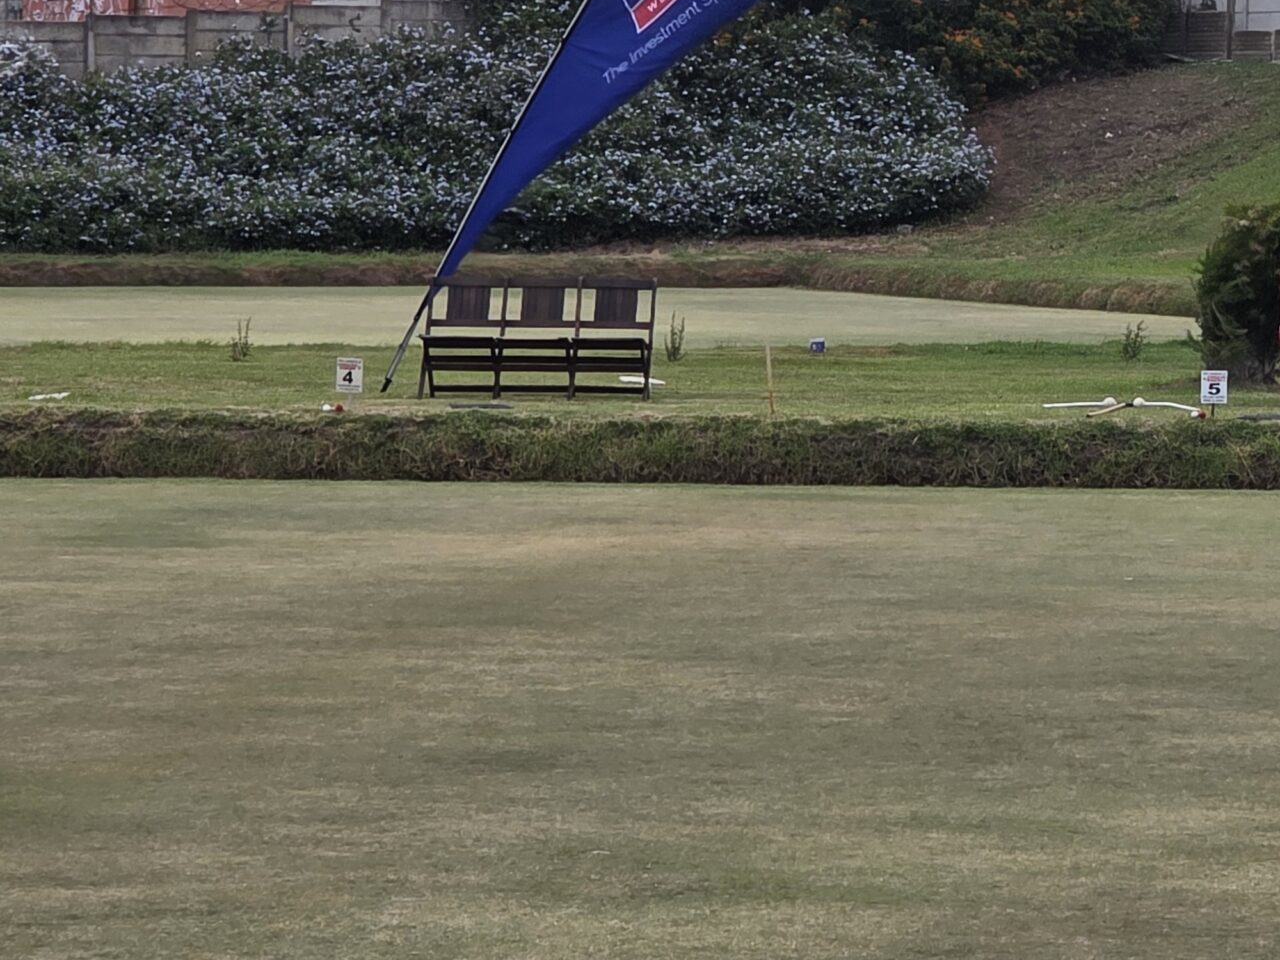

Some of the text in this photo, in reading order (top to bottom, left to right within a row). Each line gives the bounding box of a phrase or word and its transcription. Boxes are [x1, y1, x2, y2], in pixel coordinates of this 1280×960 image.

[602, 60, 628, 84] The
[628, 1, 702, 64] Investment
[342, 371, 354, 384] 4
[1208, 382, 1221, 395] 5
